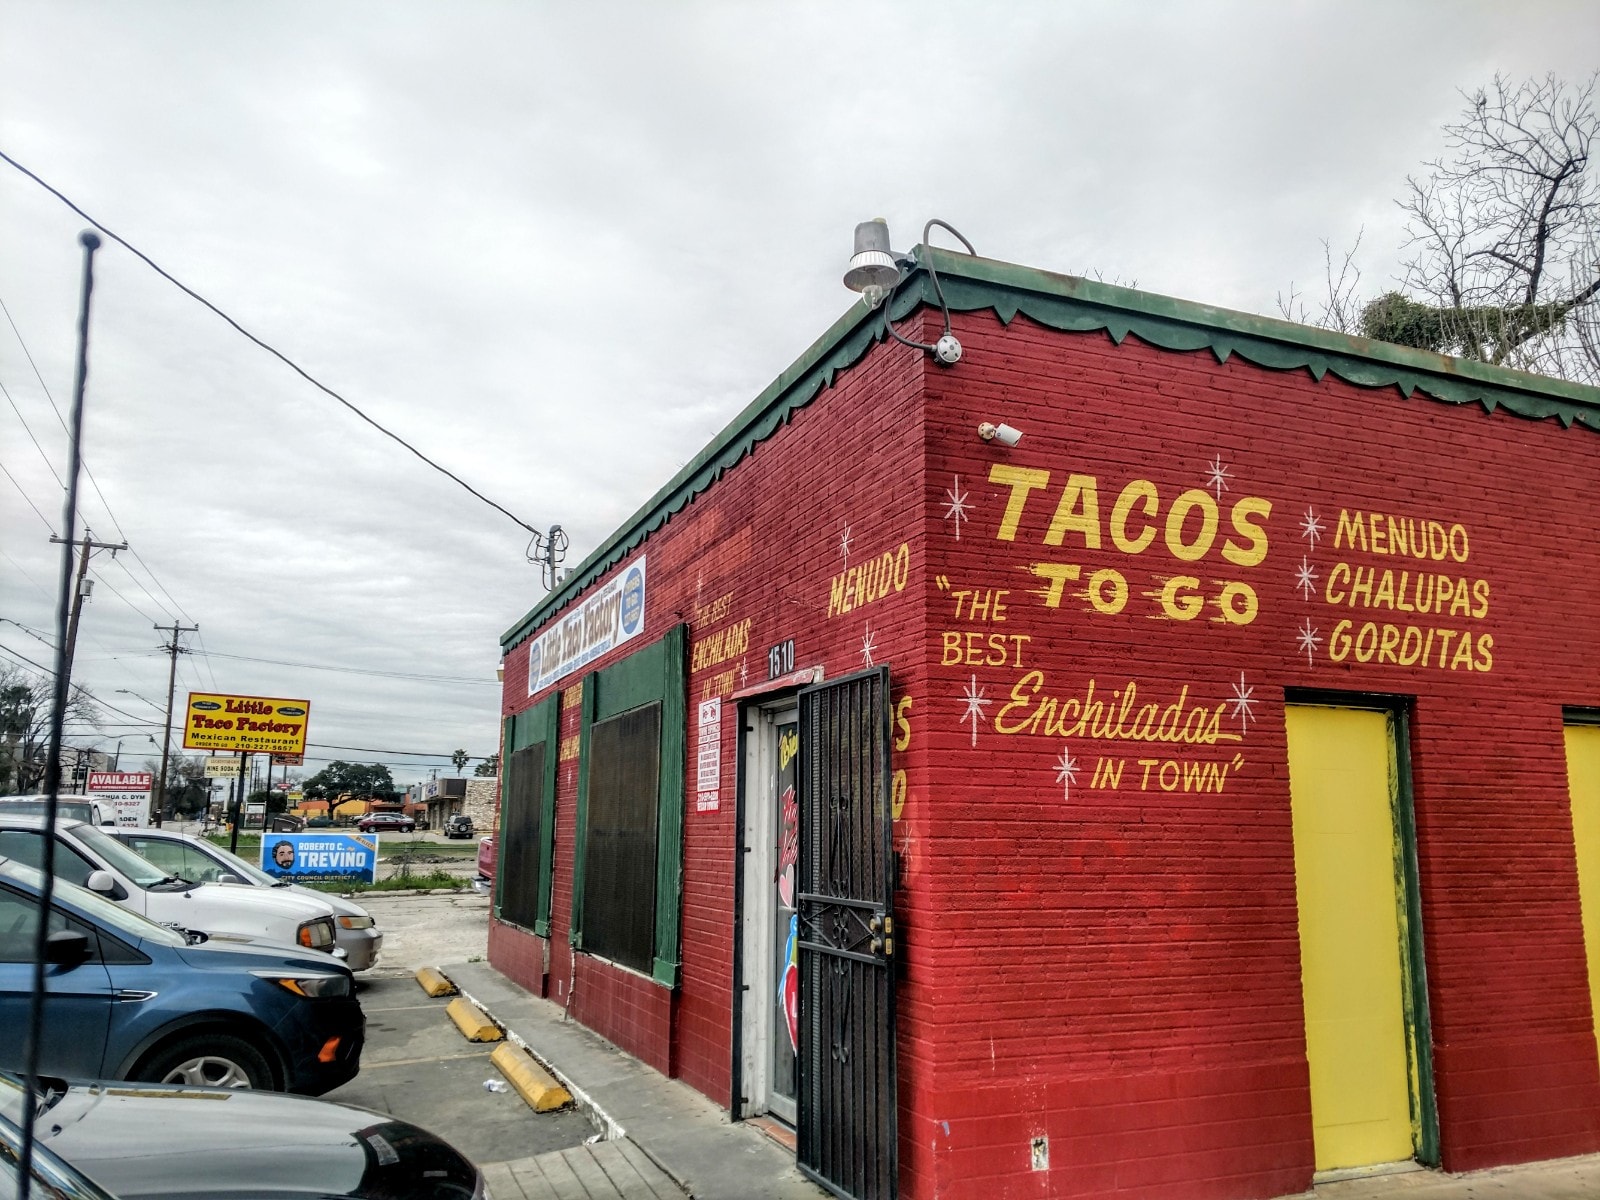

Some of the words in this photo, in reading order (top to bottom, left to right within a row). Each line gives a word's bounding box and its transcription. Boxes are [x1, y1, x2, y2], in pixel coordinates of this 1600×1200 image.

[988, 463, 1273, 567] TACOS
[1333, 508, 1470, 563] MENUDO
[827, 543, 910, 618] MENUDO
[1026, 563, 1129, 615] TO
[1150, 575, 1259, 626] GO
[1325, 562, 1490, 619] CHALUPAS
[691, 617, 753, 673] ENCHILADAS
[769, 640, 795, 679] 1510
[940, 631, 1031, 668] BEST
[1328, 619, 1494, 672] GORDITAS
[192, 715, 234, 729] Taco
[236, 717, 302, 736] Factory
[225, 699, 274, 715] Little
[994, 670, 1243, 744] Enchiladas
[191, 733, 236, 742] Mexican
[240, 736, 299, 745] Restaurant
[90, 774, 150, 785] AVAILABLE
[1090, 757, 1125, 790] IN
[298, 842, 335, 851] ROBERTO
[337, 842, 345, 851] C.
[298, 847, 367, 868] TREVIÑO
